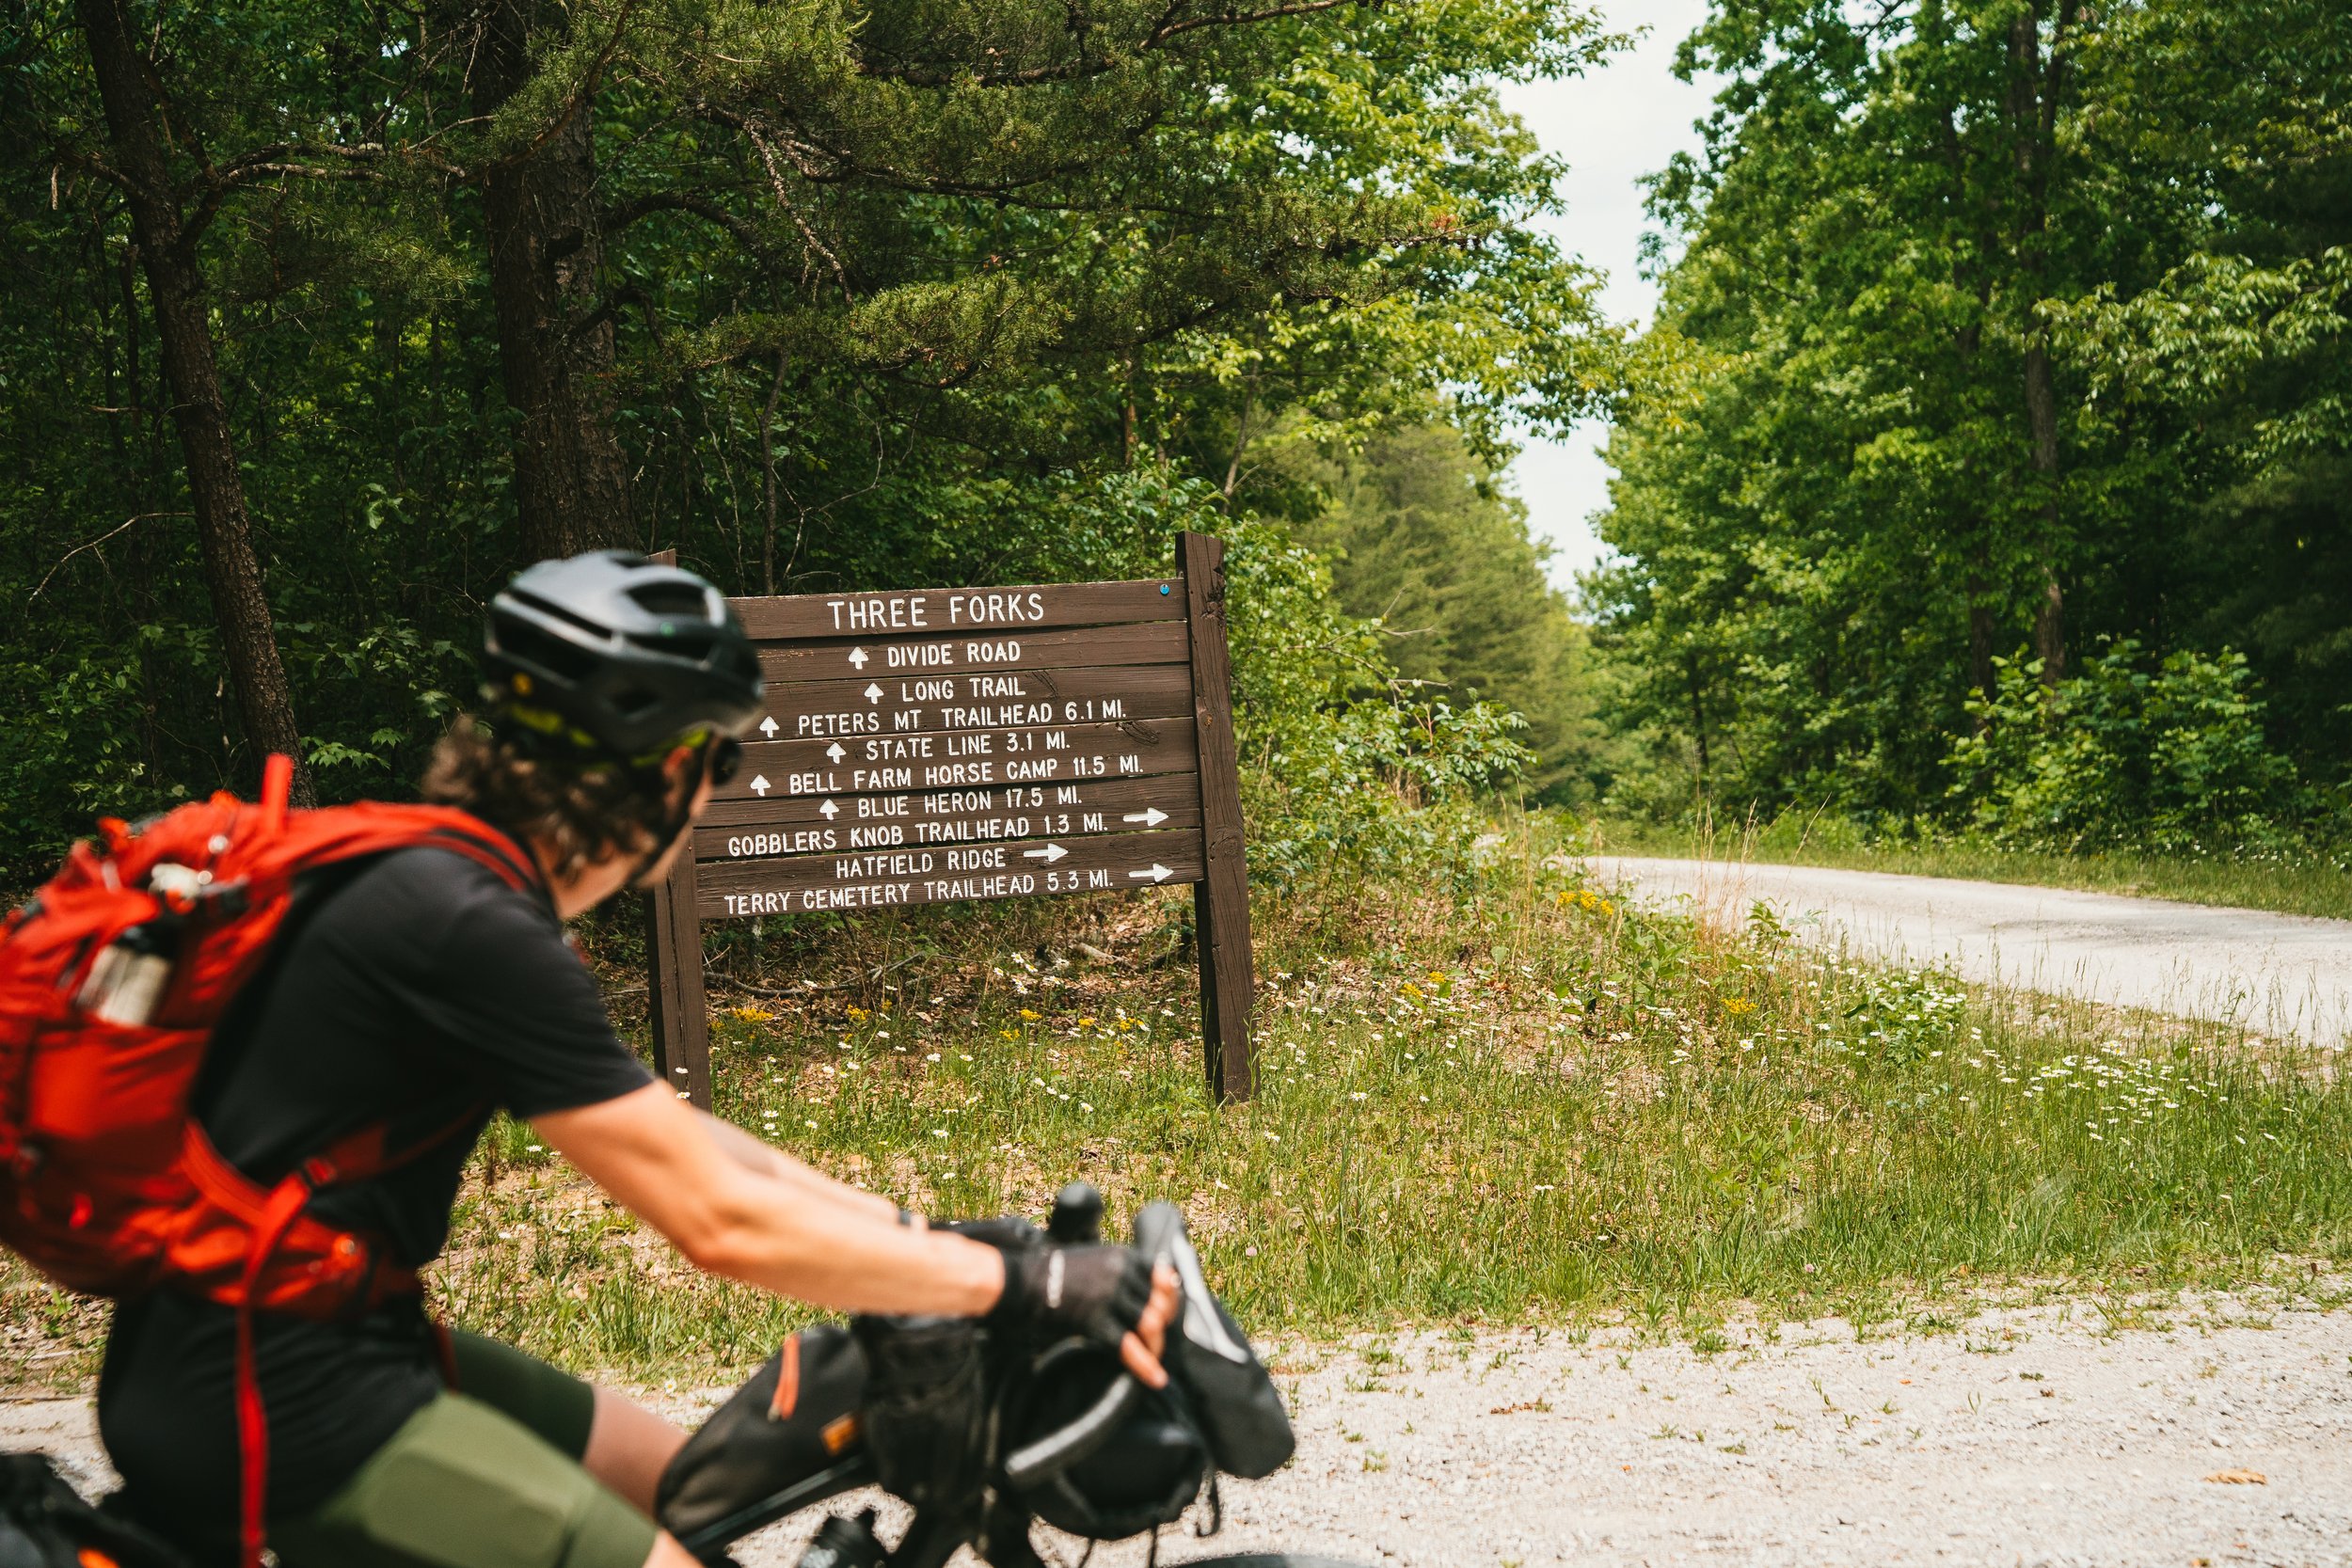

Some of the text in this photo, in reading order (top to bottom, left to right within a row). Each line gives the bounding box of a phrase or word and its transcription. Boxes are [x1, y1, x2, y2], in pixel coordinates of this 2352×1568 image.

[826, 593, 1044, 630] THREE FORKS
[887, 641, 1021, 668] DIVIDE ROAD
[901, 676, 1026, 703] LONG TRAIL
[798, 699, 1127, 736] PETERS MT TRAILHEAD 6.1 MI.
[866, 730, 1071, 761] STATE LINE 3.1 MI.
[789, 753, 1144, 795] BELL FARM HORSE CAMP 11.5 MI.
[857, 784, 1083, 818] BLUE HERON 17.5 MI.
[728, 812, 1108, 857] GOBBLERS KNOB TRAILHEAD 1.3 MI.
[835, 847, 1007, 879] HATFIELD RIDGE
[723, 868, 1114, 915] TERRY CEMETERY TRAILHEAD 5.3 MI.
